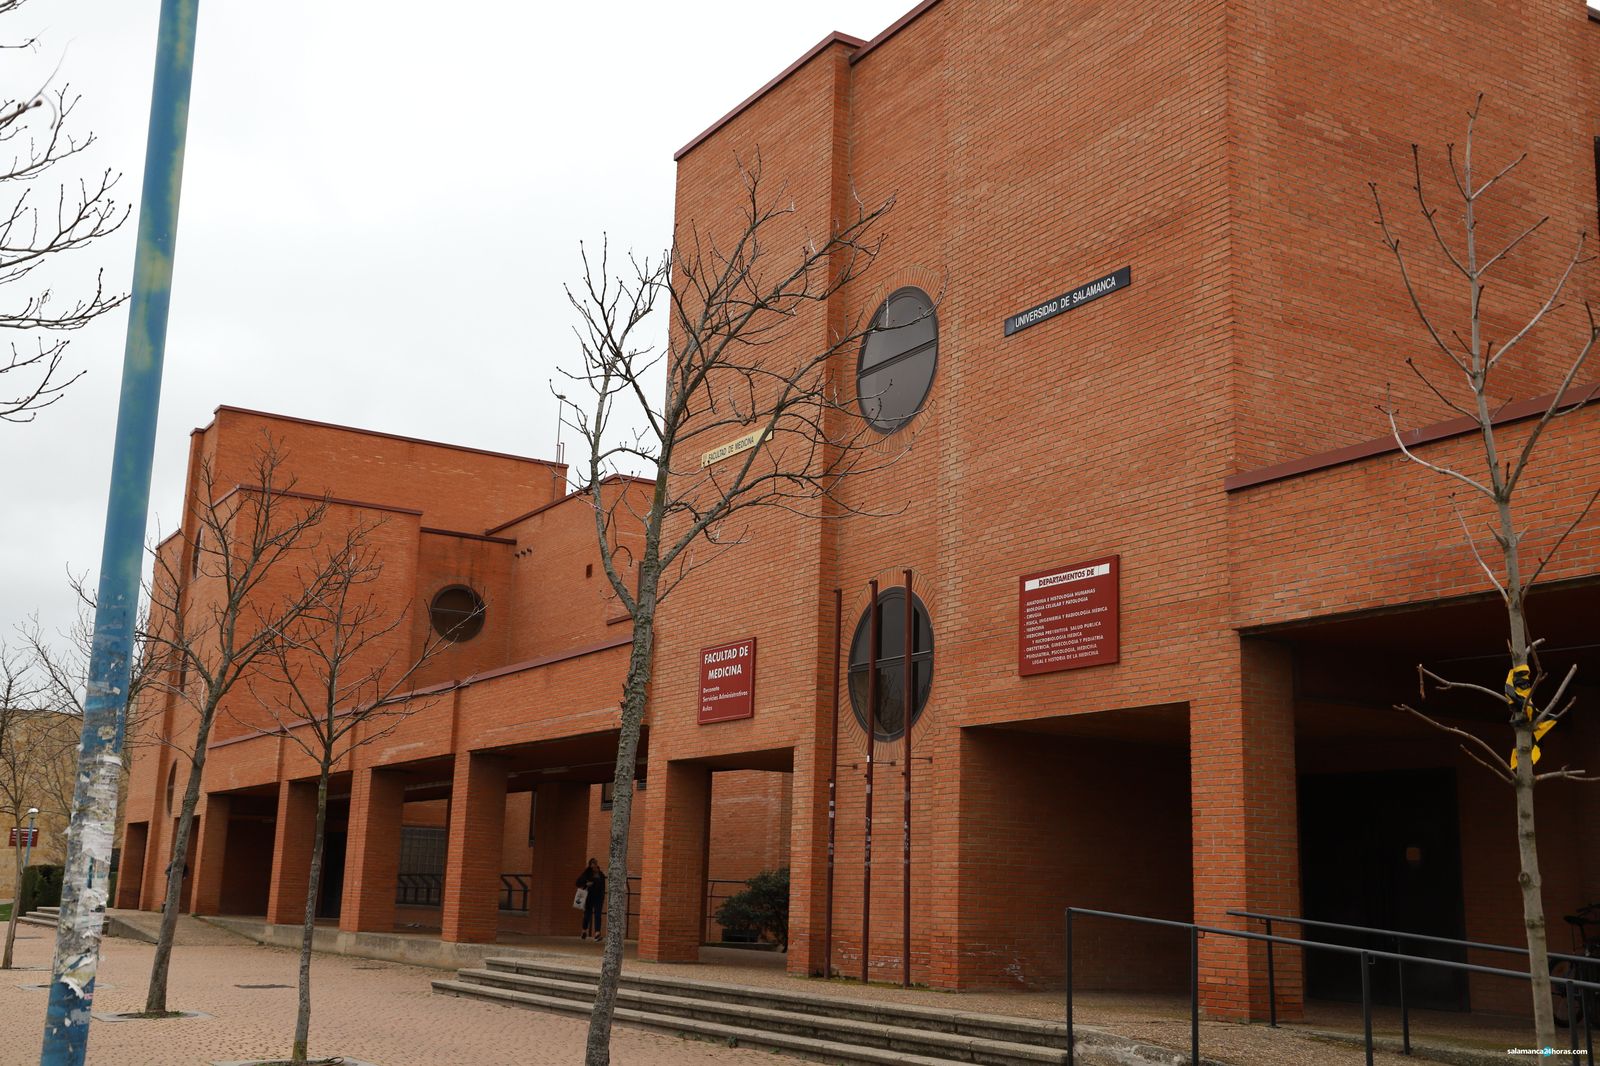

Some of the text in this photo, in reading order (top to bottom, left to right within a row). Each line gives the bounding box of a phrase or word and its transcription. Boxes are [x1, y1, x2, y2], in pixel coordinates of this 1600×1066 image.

[1015, 277, 1116, 327] UNIVERSIDAD DE SALAMANCA
[728, 445, 734, 453] DE
[1039, 568, 1094, 587] DEPARTAMENTOS DE
[704, 646, 748, 664] FACULTAD DE
[708, 664, 742, 680] MEDICINA
[719, 690, 748, 700] Administrativos
